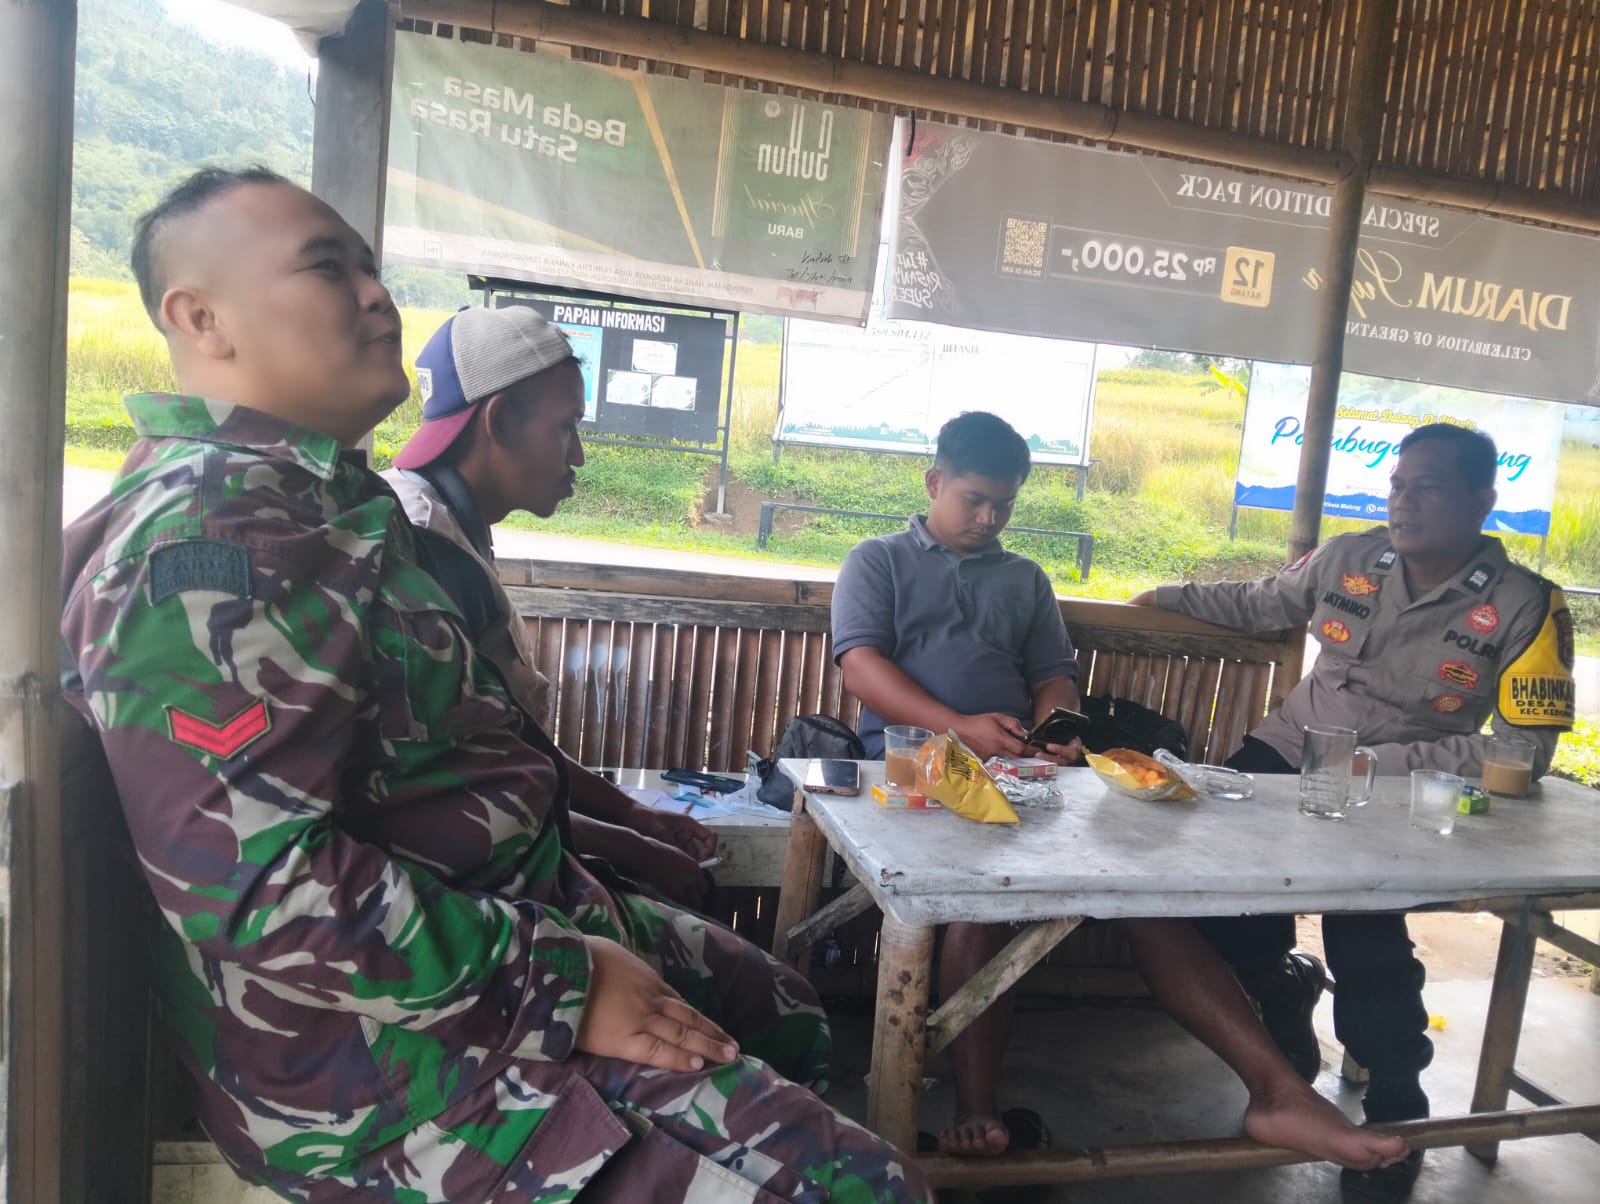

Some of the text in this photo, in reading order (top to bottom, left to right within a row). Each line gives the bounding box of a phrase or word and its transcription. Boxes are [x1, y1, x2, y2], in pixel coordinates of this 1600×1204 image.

[553, 305, 666, 333] PAPAN INFORMASI
[1335, 405, 1378, 421] Selamat
[1379, 409, 1420, 430] Datang
[1515, 700, 1556, 708] DESA
